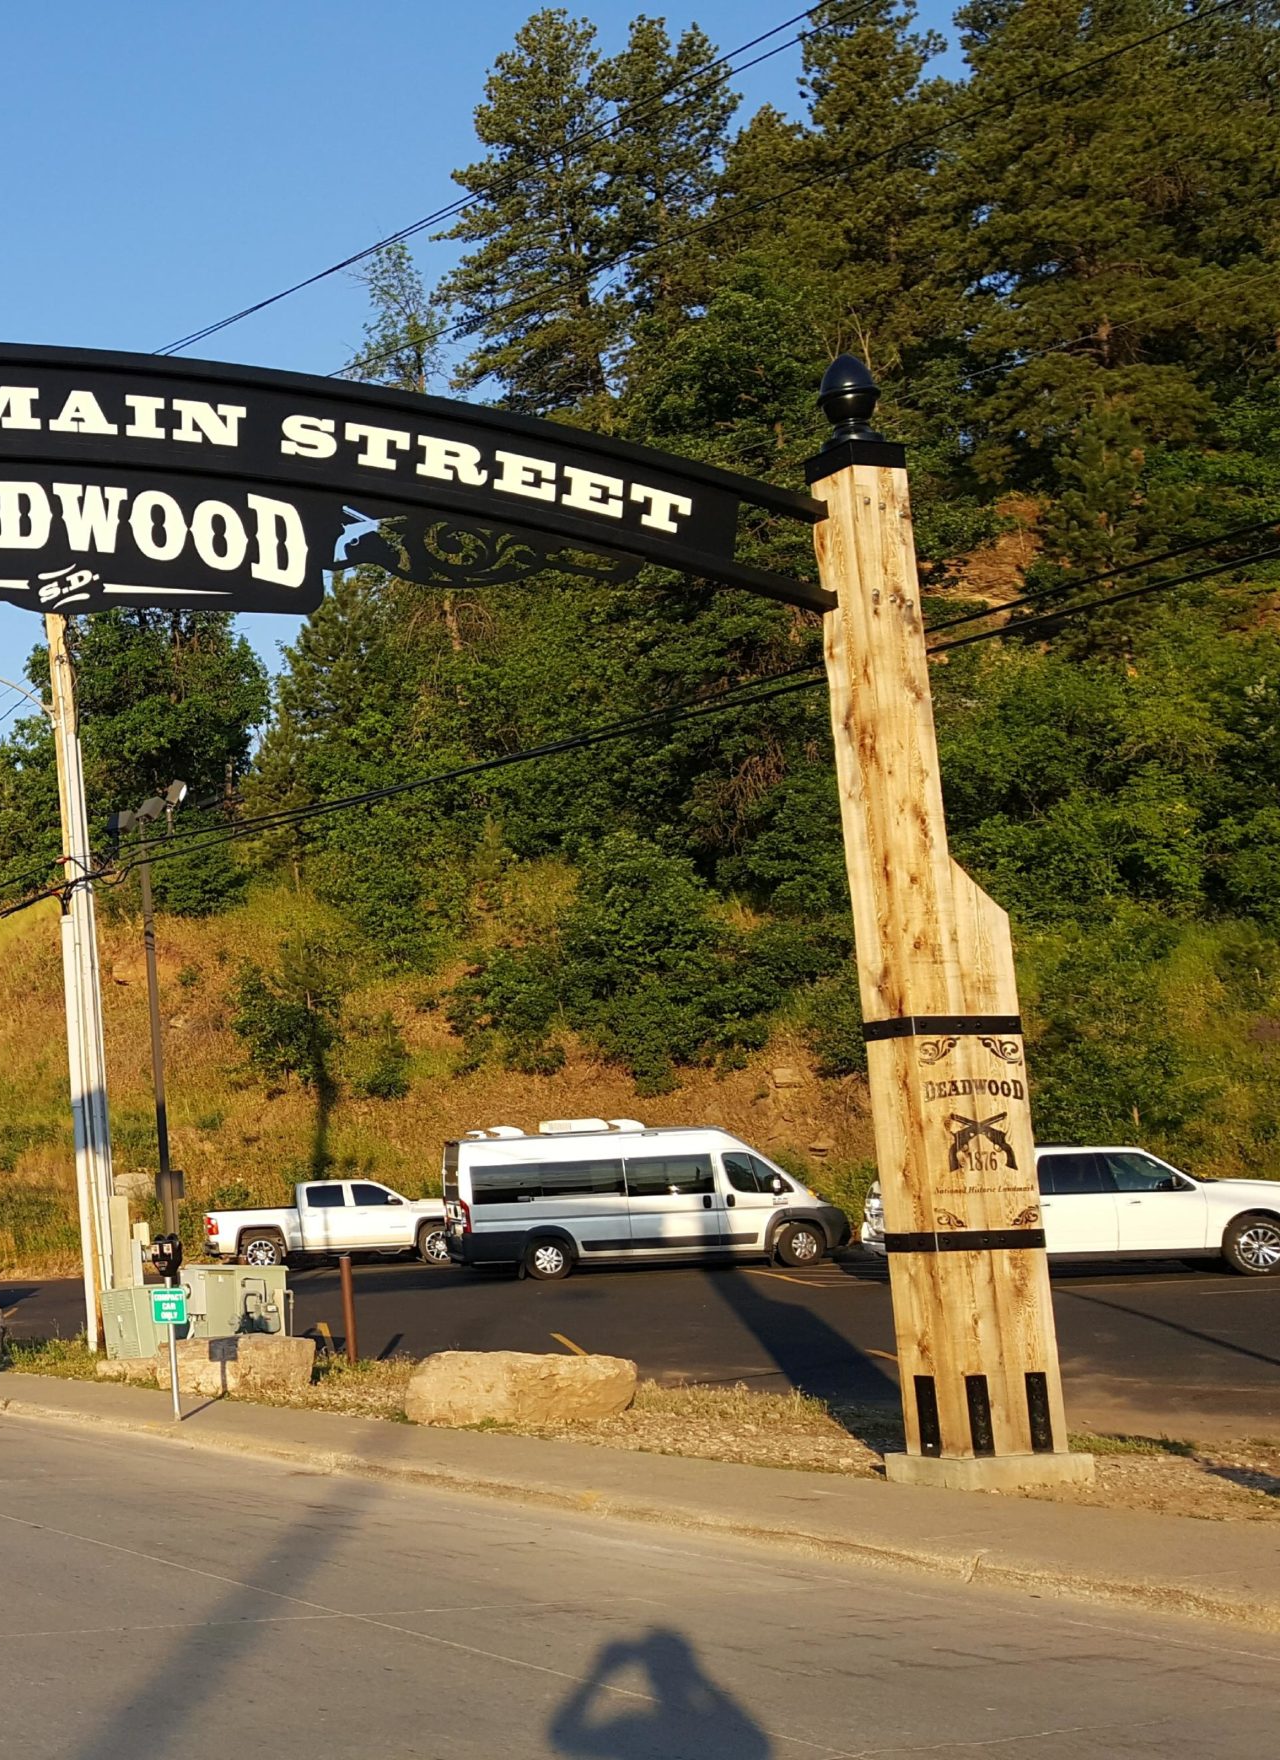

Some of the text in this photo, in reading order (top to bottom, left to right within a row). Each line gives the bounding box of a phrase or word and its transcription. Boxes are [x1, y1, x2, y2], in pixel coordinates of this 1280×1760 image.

[281, 416, 692, 536] STREET
[38, 568, 100, 604] S.D.
[924, 1079, 1024, 1102] DEADWOOD
[968, 1151, 998, 1172] 1876
[935, 1184, 1034, 1195] National Historic Landmark
